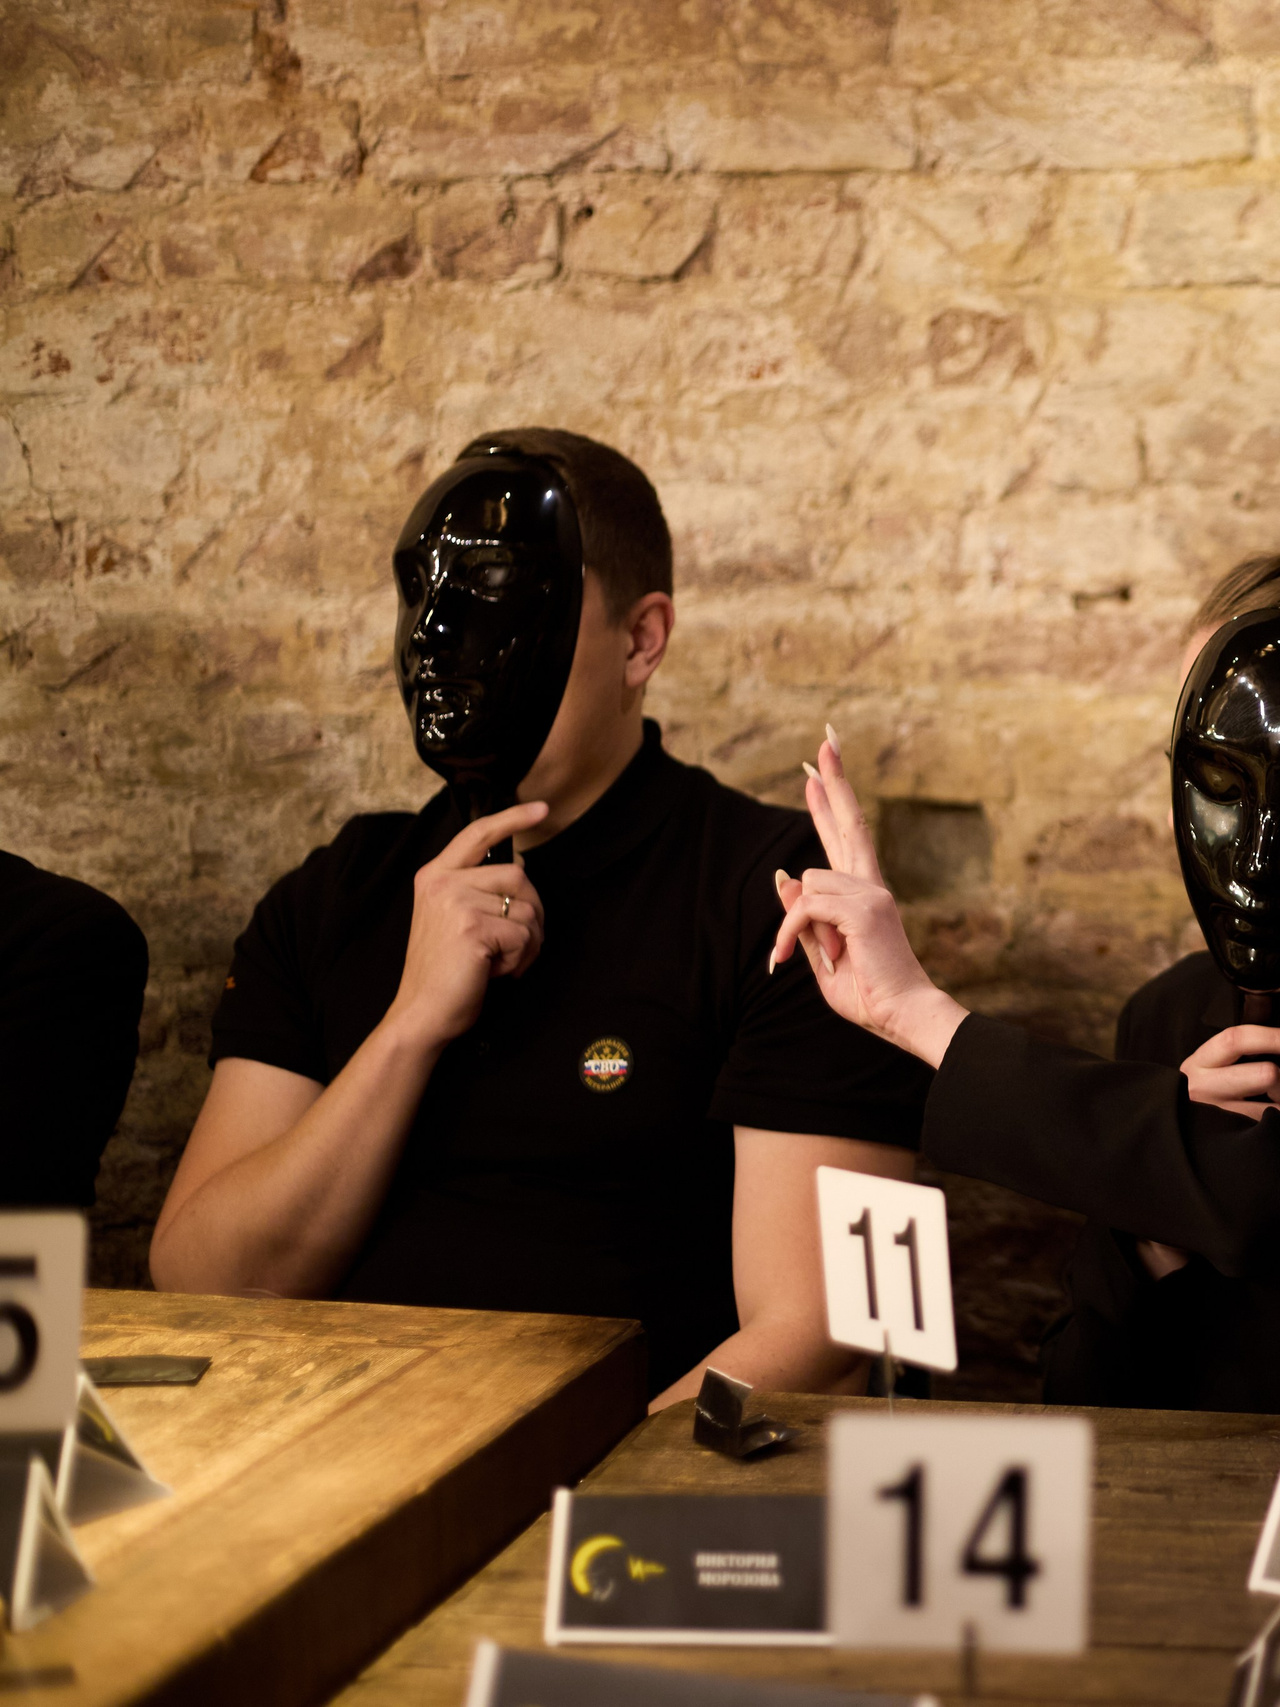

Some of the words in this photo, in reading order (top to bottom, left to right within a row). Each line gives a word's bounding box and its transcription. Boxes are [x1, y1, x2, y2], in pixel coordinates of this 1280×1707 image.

[591, 1060, 620, 1075] СВО
[848, 1206, 925, 1332] 11
[877, 1461, 1040, 1610] 14
